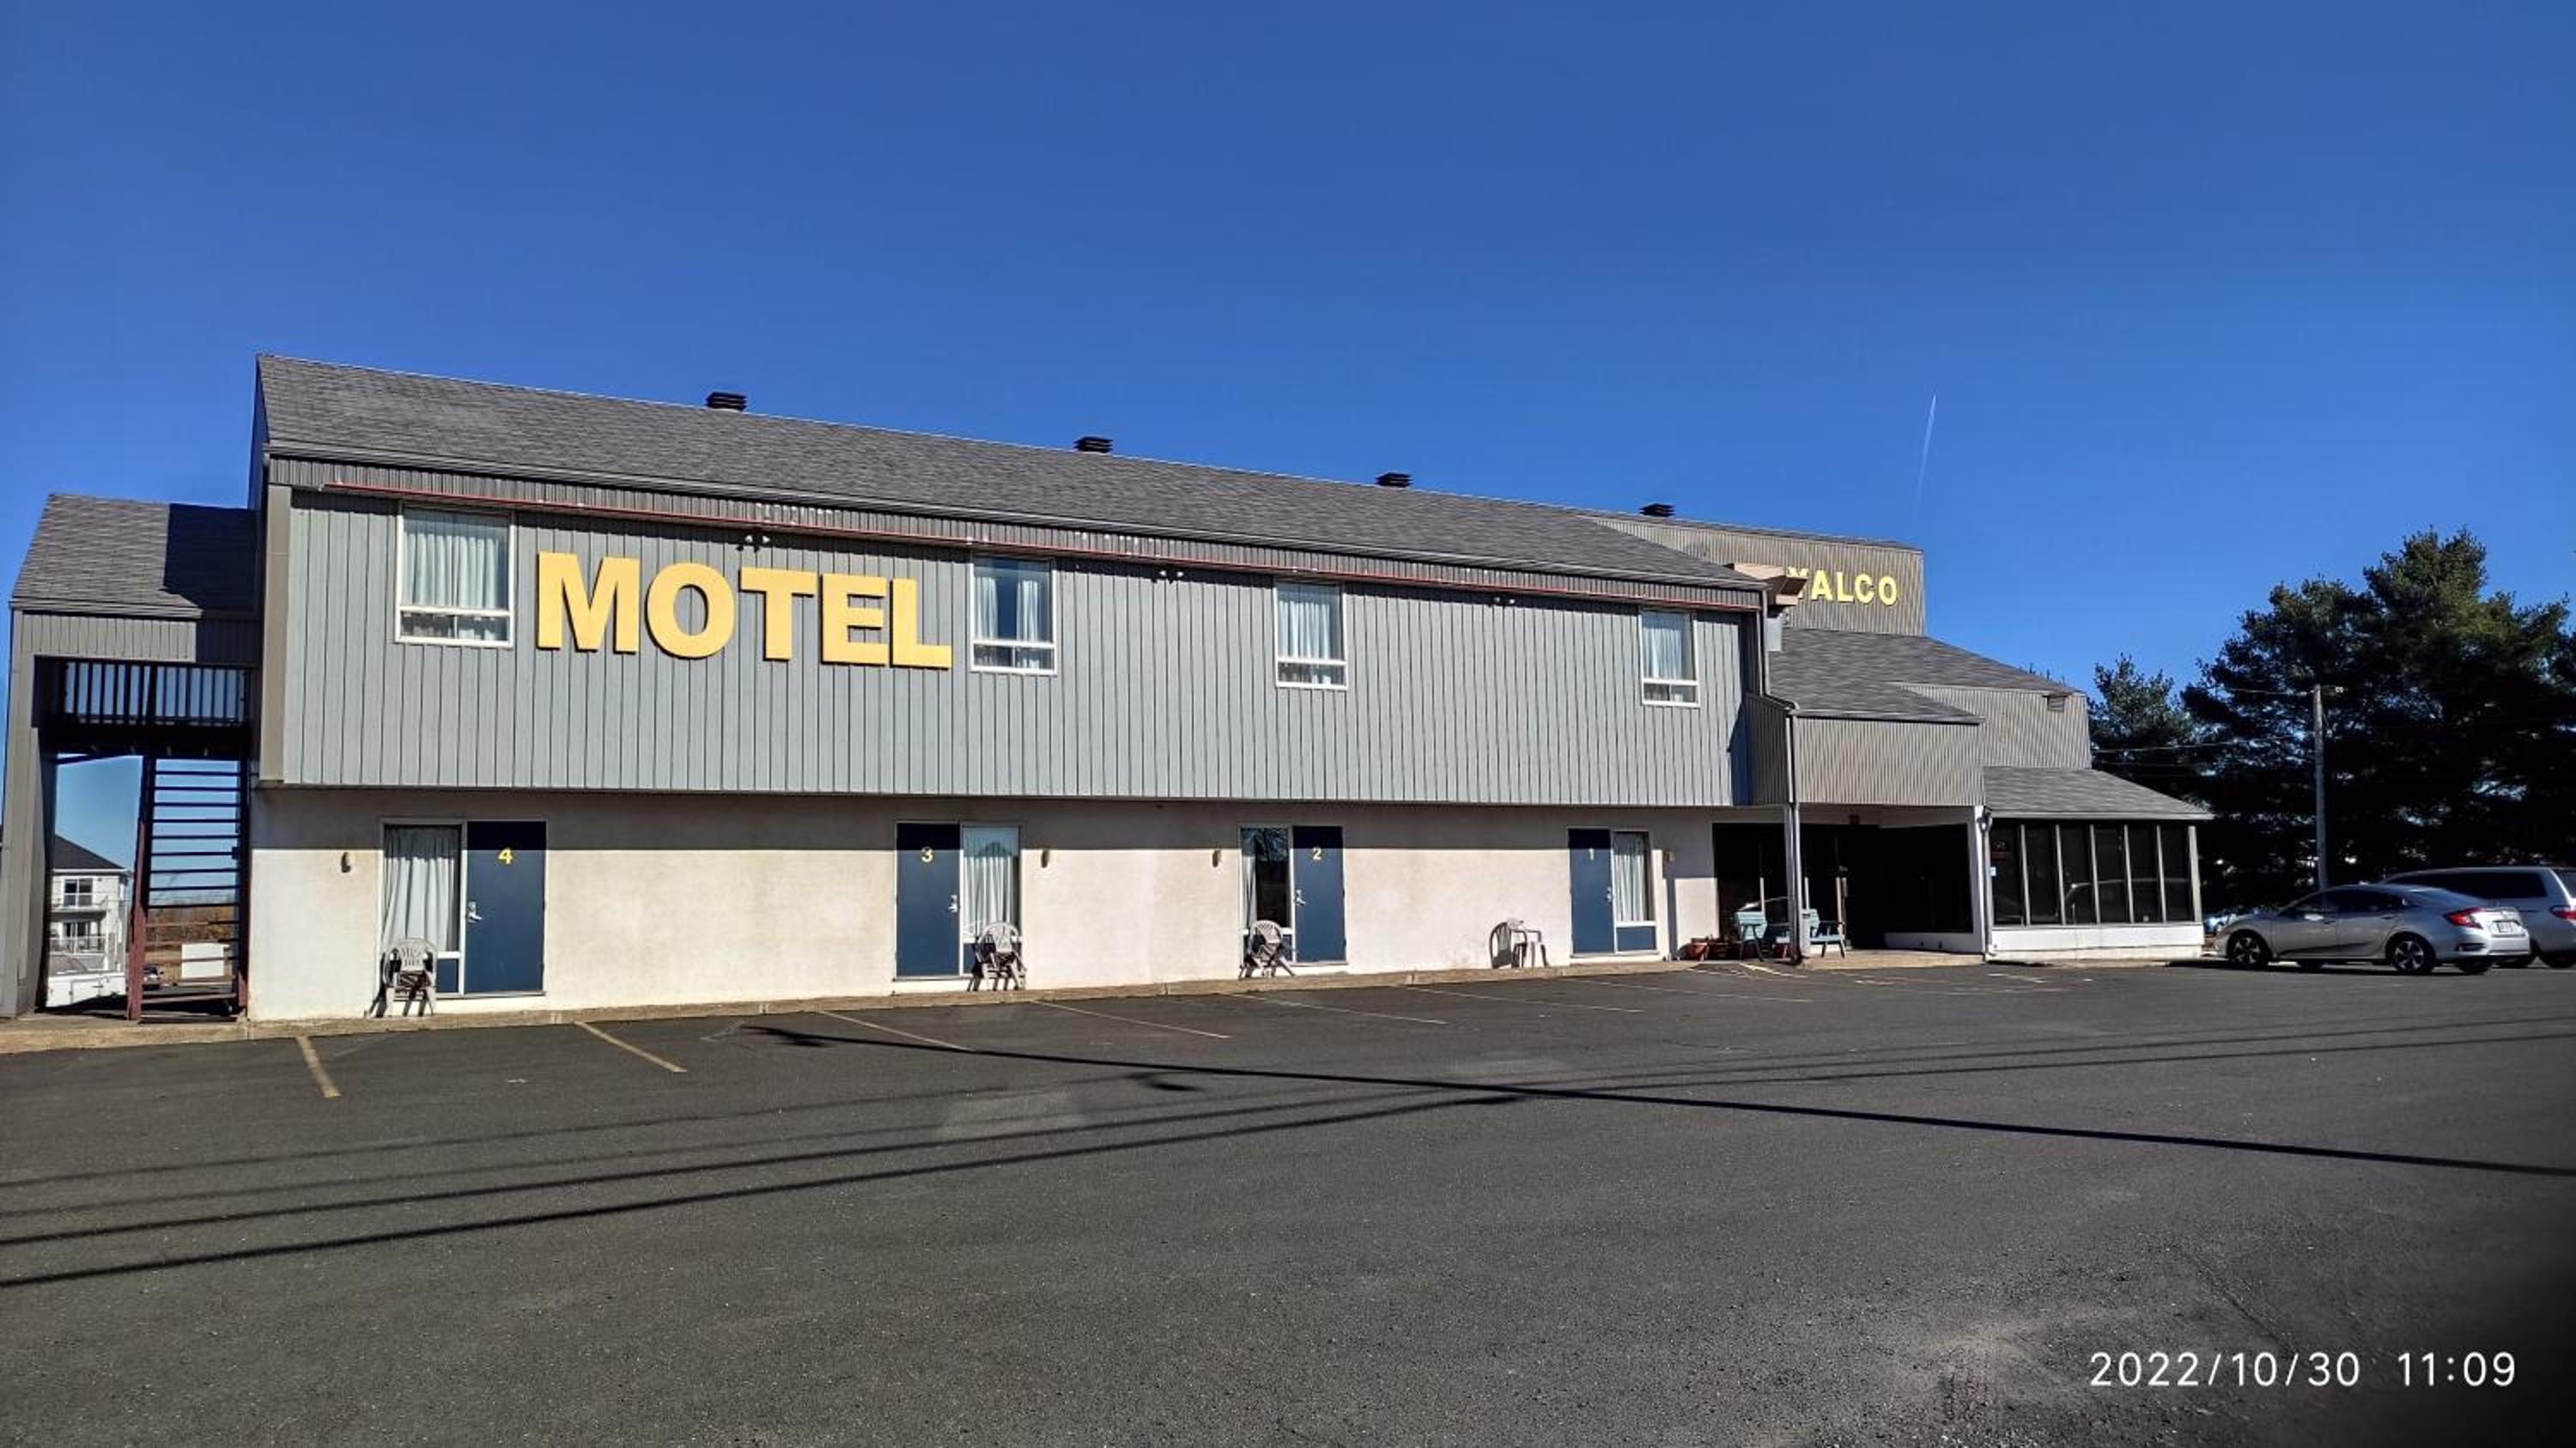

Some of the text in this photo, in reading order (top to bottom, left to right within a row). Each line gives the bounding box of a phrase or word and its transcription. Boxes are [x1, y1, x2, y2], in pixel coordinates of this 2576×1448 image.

[537, 550, 953, 669] MOTEL
[498, 847, 513, 865] 4
[920, 846, 933, 863] 3
[1312, 847, 1321, 861] 2
